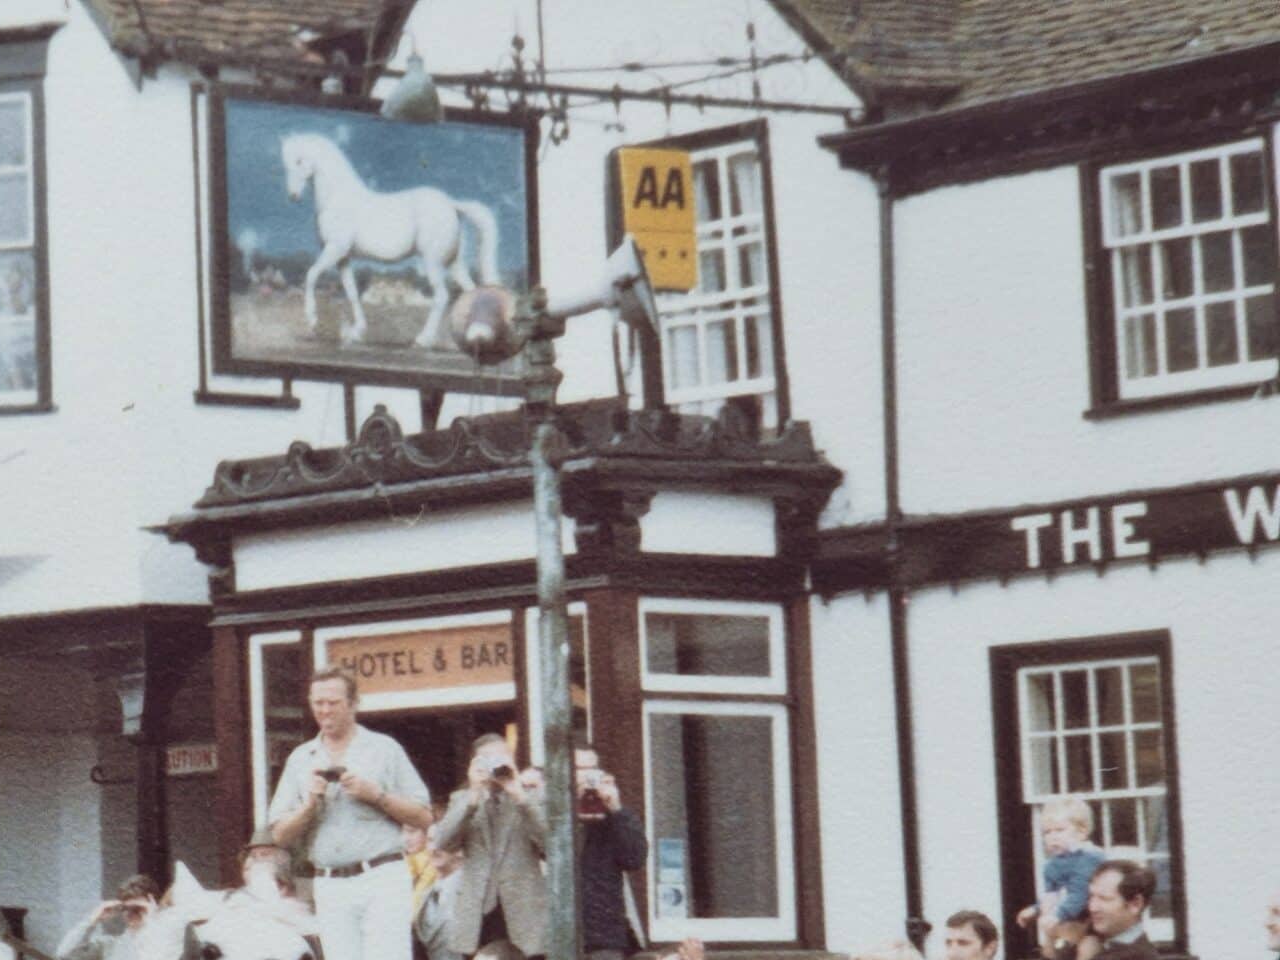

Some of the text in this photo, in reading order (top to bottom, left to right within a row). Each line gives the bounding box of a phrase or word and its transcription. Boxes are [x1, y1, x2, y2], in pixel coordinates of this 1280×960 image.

[633, 166, 685, 210] AA
[1011, 484, 1280, 569] THE W
[341, 641, 509, 678] HOTEL & BAR
